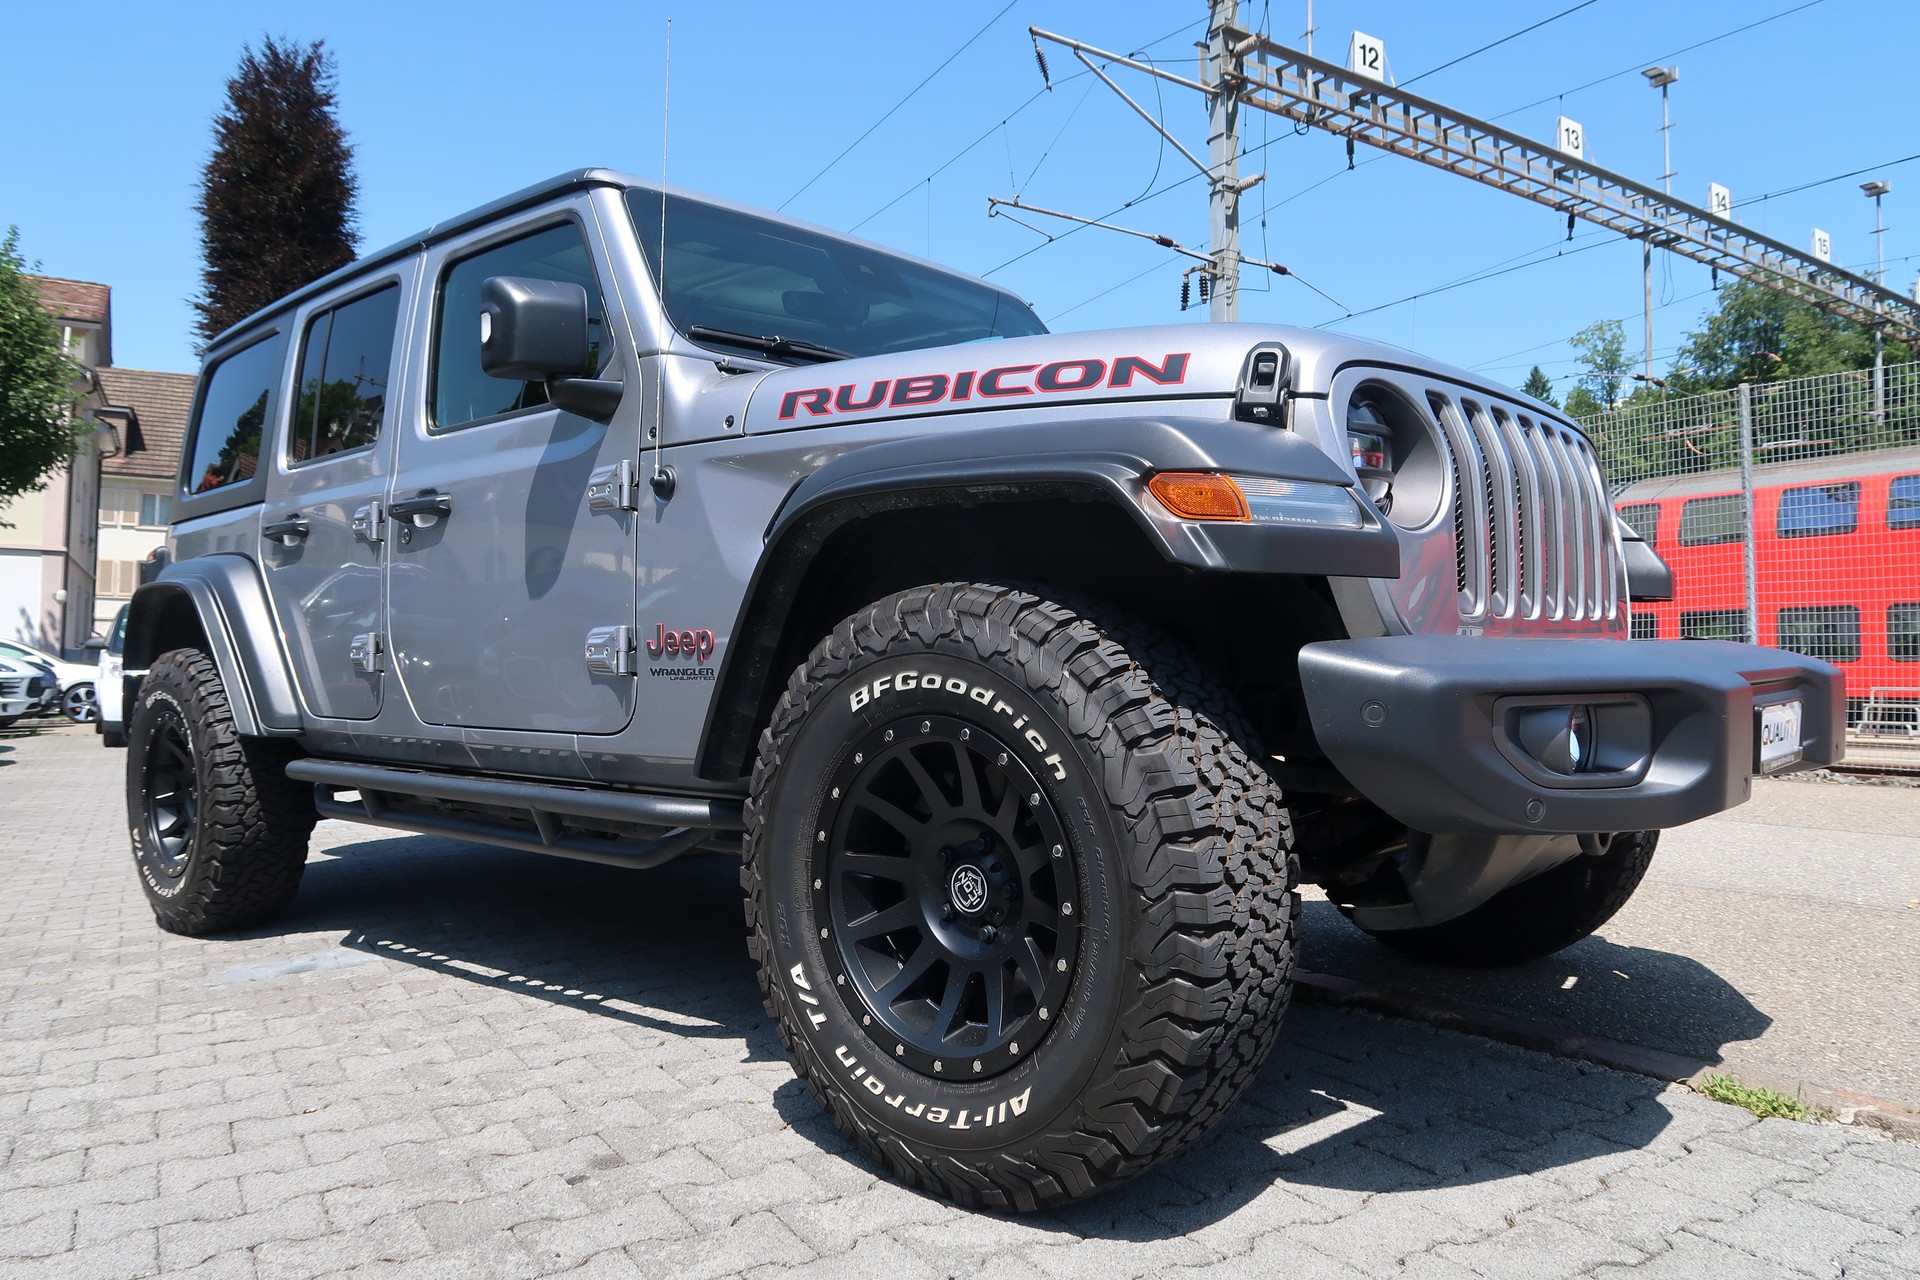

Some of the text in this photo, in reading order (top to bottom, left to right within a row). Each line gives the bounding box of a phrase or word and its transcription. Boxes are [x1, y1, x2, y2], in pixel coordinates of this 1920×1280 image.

[1358, 43, 1380, 72] 12
[1564, 127, 1580, 150] 13
[1714, 192, 1728, 212] 14
[1817, 237, 1829, 256] 15
[777, 352, 1191, 421] RUBICON
[646, 622, 715, 663] Jeep
[649, 667, 715, 677] WRANGLER
[849, 670, 1068, 781] BFGoodrich
[789, 961, 828, 1032] T/A
[835, 1044, 1033, 1130] All-Terrain
